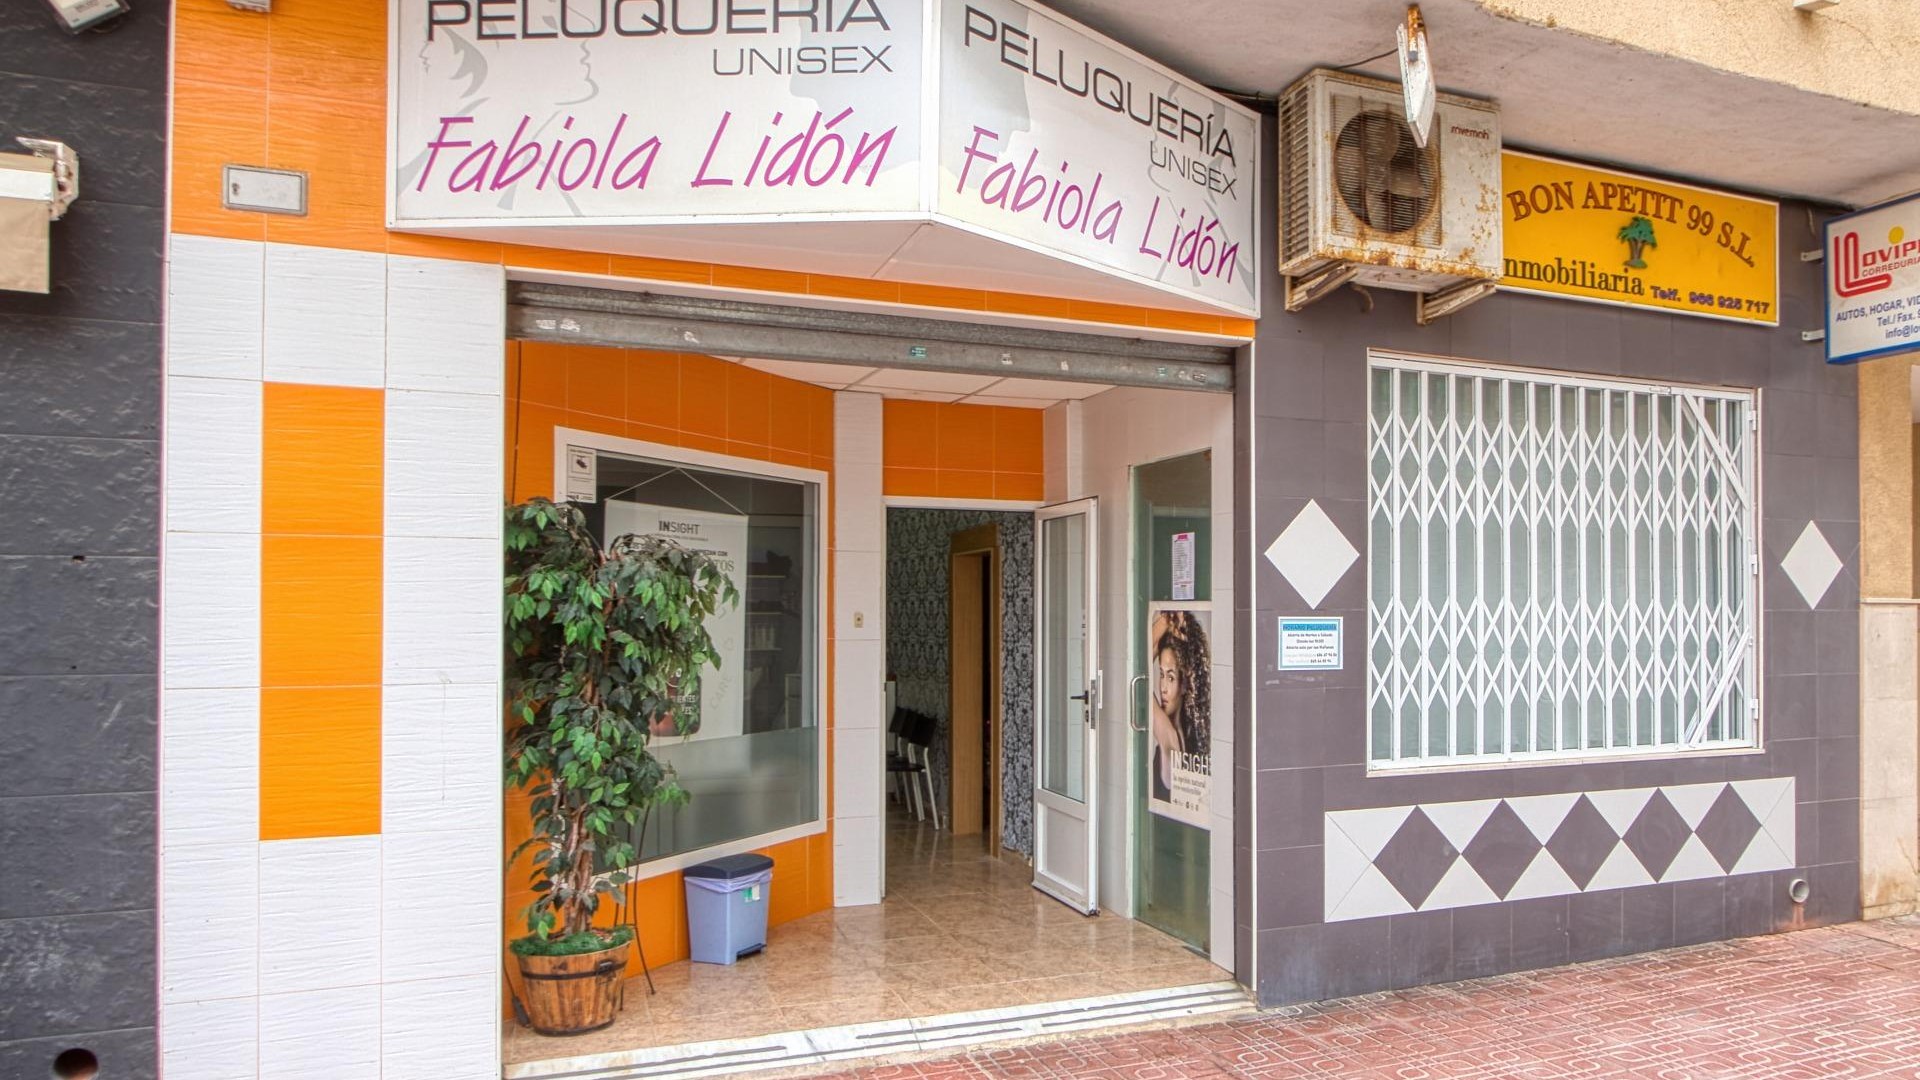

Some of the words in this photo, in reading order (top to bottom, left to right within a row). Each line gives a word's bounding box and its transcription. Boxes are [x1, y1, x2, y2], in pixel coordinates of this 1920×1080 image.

[713, 45, 893, 75] UNISEX
[964, 4, 1237, 167] PELUQUERÍA
[417, 113, 662, 193] Fabiola
[690, 107, 898, 188] Lidón
[1150, 140, 1237, 200] UNISEX
[956, 125, 1124, 245] Fabiola
[1139, 196, 1240, 284] Lidón
[1506, 181, 1575, 222] BON
[1582, 181, 1684, 224] APETIT
[1686, 204, 1714, 236] 99
[1717, 221, 1755, 268] S.L.
[1503, 257, 1645, 296] nmobiliaria
[1745, 299, 1770, 314] 717
[659, 520, 701, 534] INSIGHT
